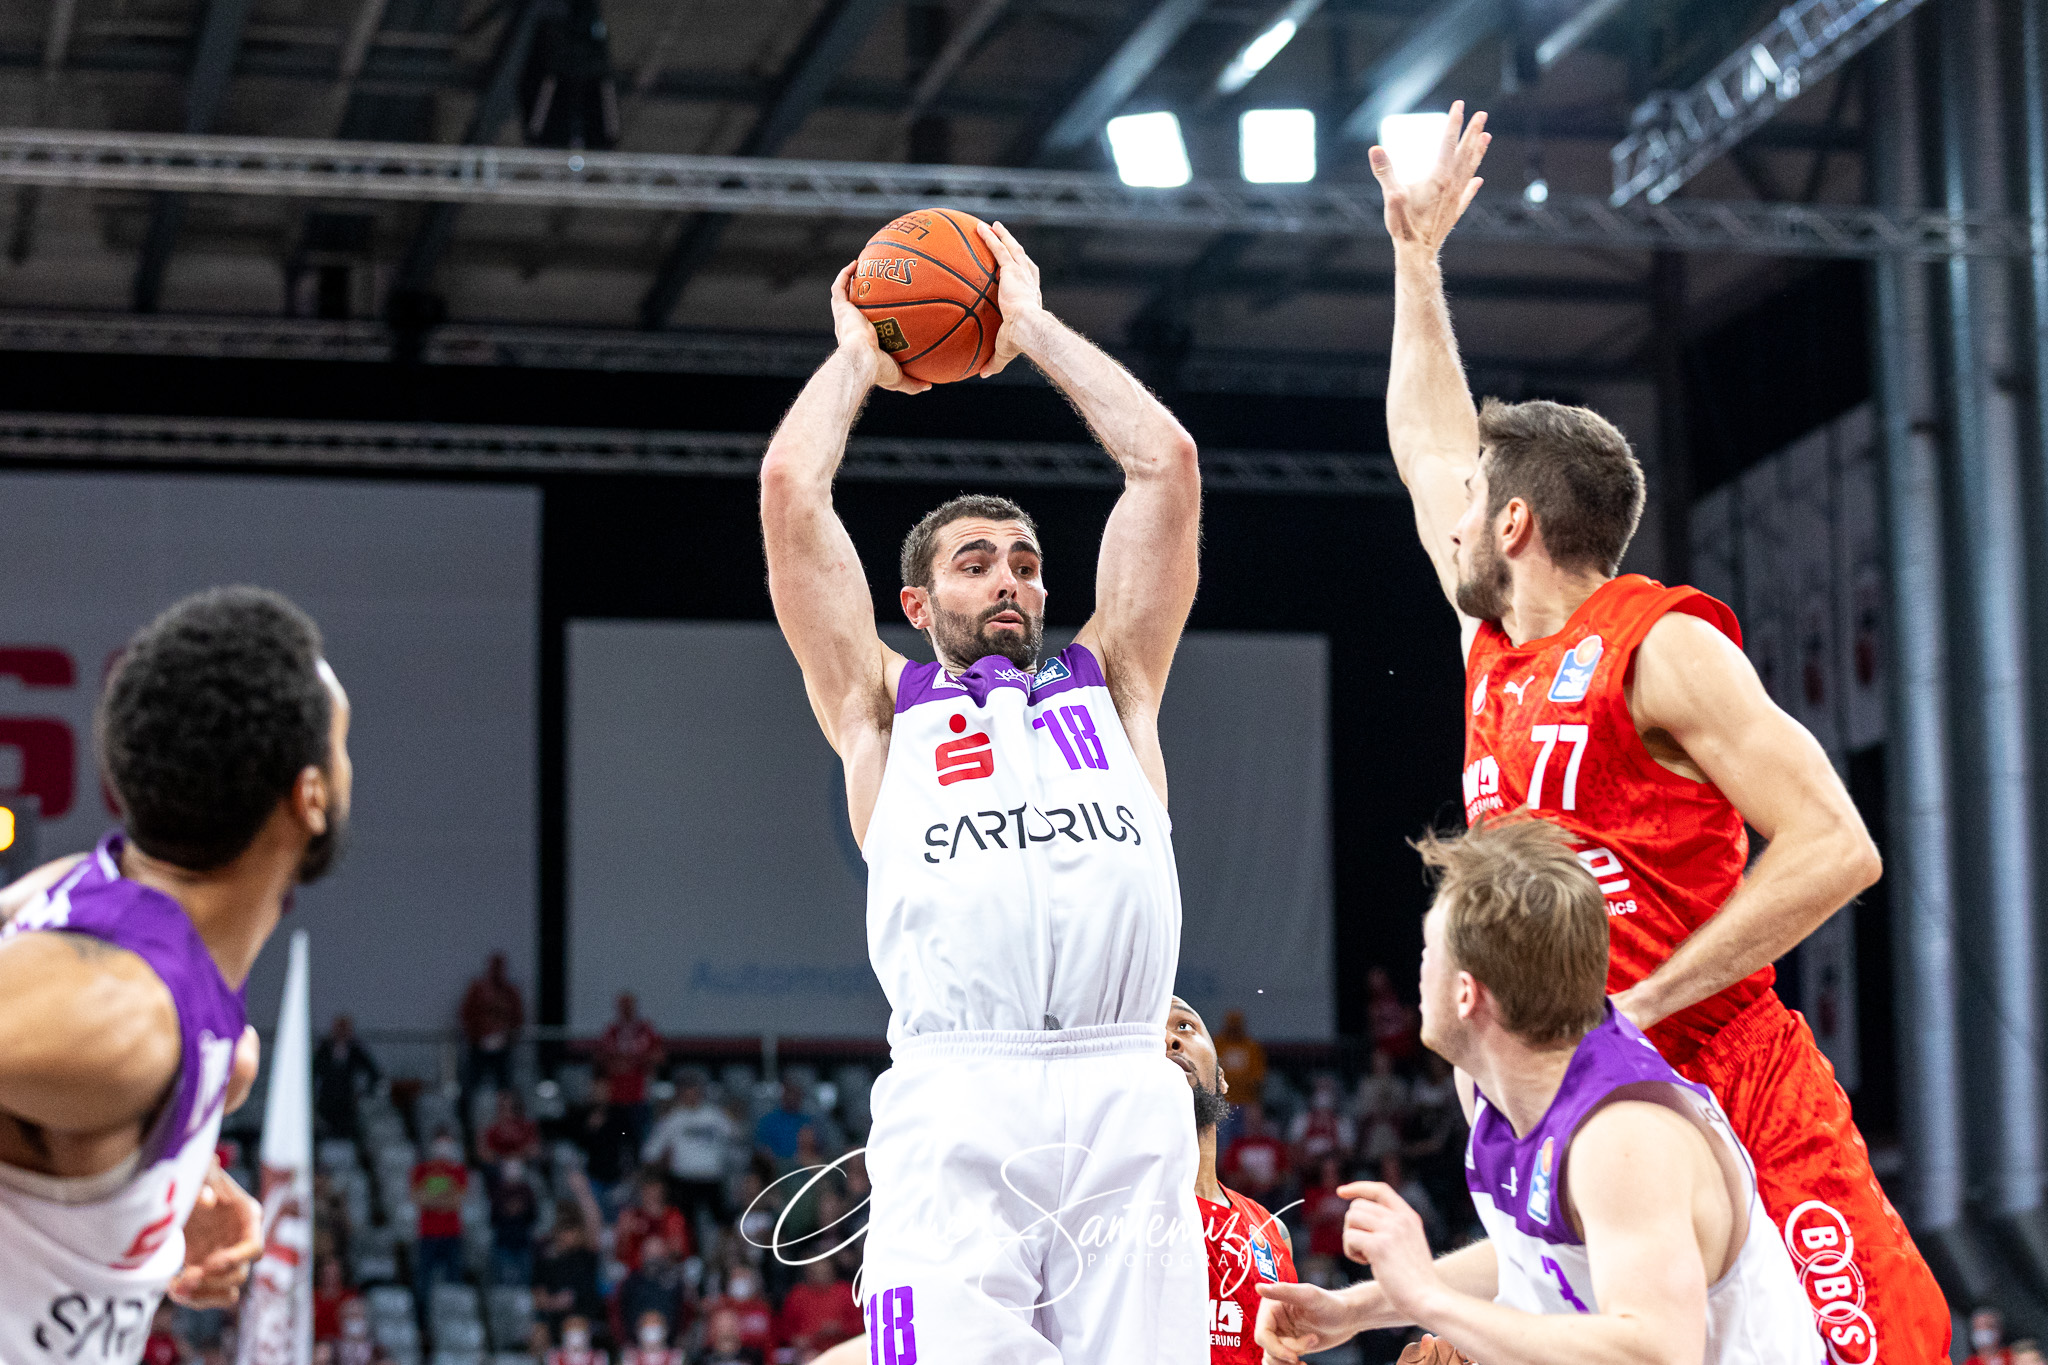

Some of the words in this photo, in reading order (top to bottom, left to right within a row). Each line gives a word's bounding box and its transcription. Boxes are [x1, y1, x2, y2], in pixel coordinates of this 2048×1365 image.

[1032, 705, 1109, 770] 18
[1527, 725, 1589, 810] 77
[924, 801, 1142, 863] SARTORIUS
